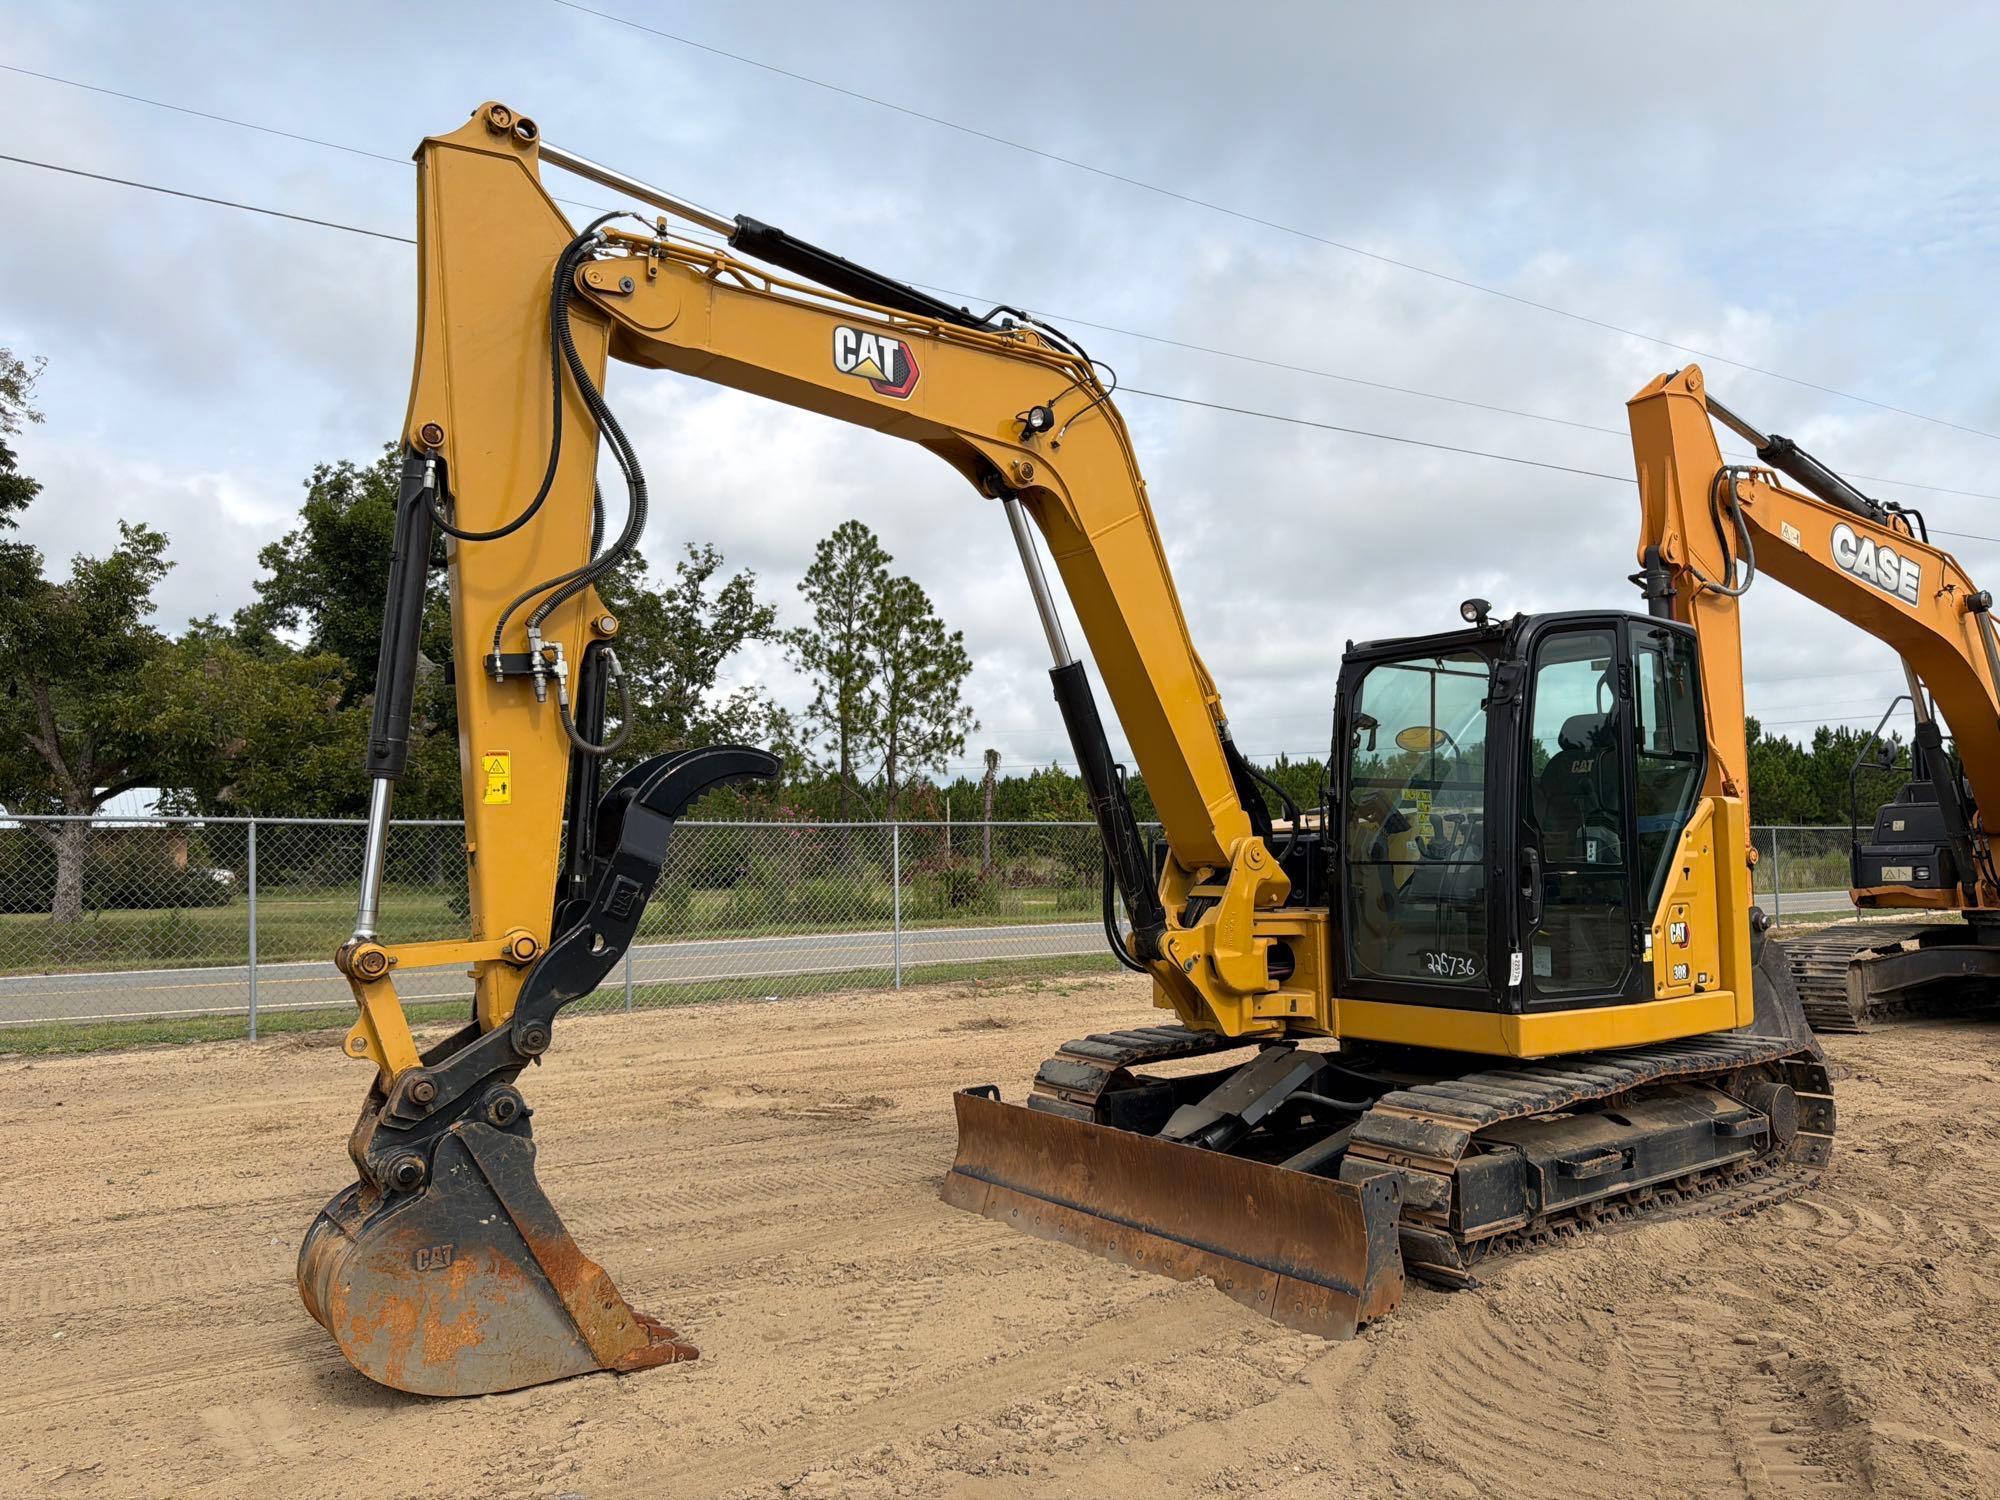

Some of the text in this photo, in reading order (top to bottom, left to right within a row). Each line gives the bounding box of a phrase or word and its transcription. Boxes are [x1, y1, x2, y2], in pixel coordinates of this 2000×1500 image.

[834, 326, 899, 382] CAT
[1832, 523, 1920, 604] CASE
[1571, 759, 1594, 773] CAT
[1670, 922, 1686, 944] CAT
[1426, 952, 1475, 976] 225736
[1673, 964, 1687, 980] 308
[416, 1243, 454, 1272] CAT
